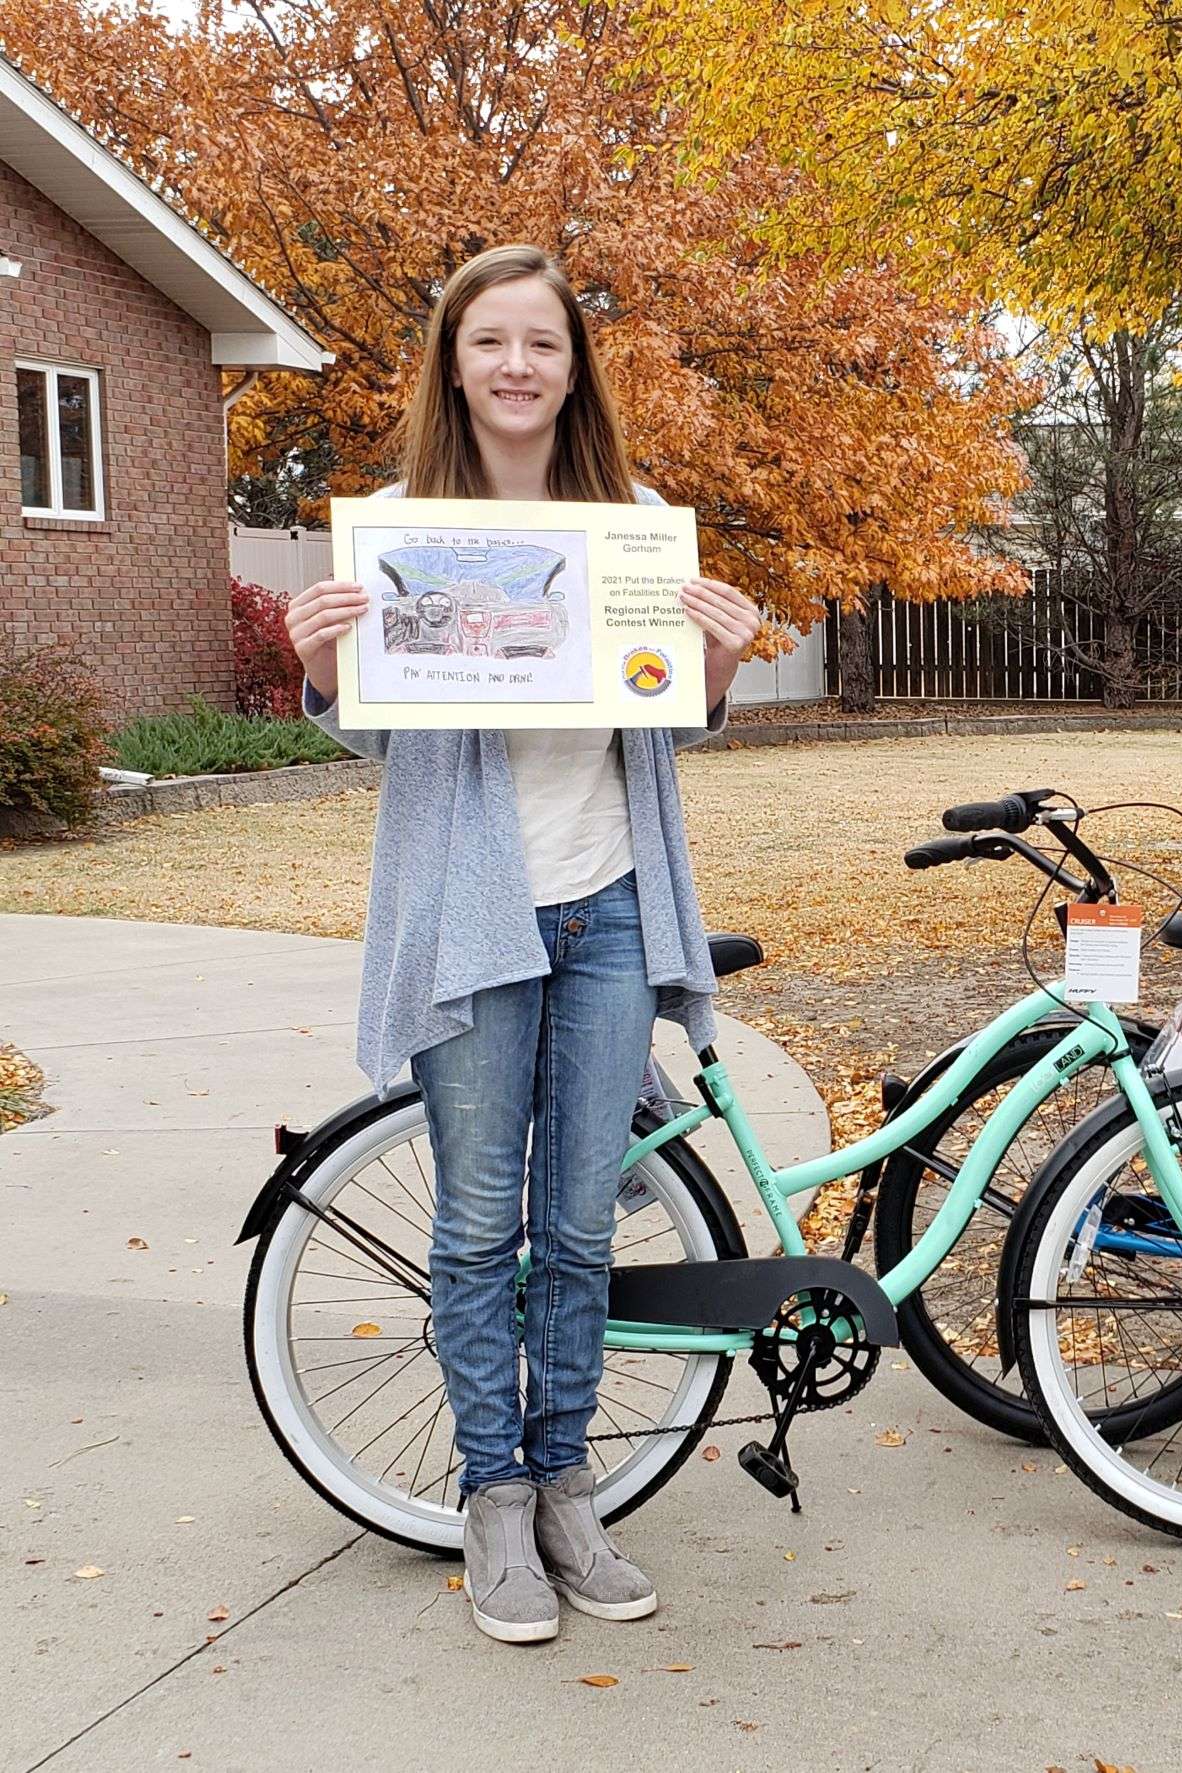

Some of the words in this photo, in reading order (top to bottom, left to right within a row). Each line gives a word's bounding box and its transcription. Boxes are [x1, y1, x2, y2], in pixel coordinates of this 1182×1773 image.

[426, 534, 446, 545] back
[452, 536, 461, 545] to
[604, 531, 647, 541] Janessa
[650, 532, 678, 542] Miller
[622, 543, 662, 553] Gorham
[601, 576, 622, 584] 2021
[625, 576, 640, 584] Put
[641, 576, 655, 584] the
[656, 576, 686, 584] Brakes
[609, 589, 621, 597] on
[622, 588, 660, 597] Fatalities
[662, 588, 679, 599] Day
[604, 605, 650, 617] Regional
[652, 605, 686, 615] Poster
[606, 618, 646, 627] Contest
[648, 618, 686, 628] Winner
[426, 669, 480, 683] ATTENTION
[1054, 1046, 1083, 1071] LAND
